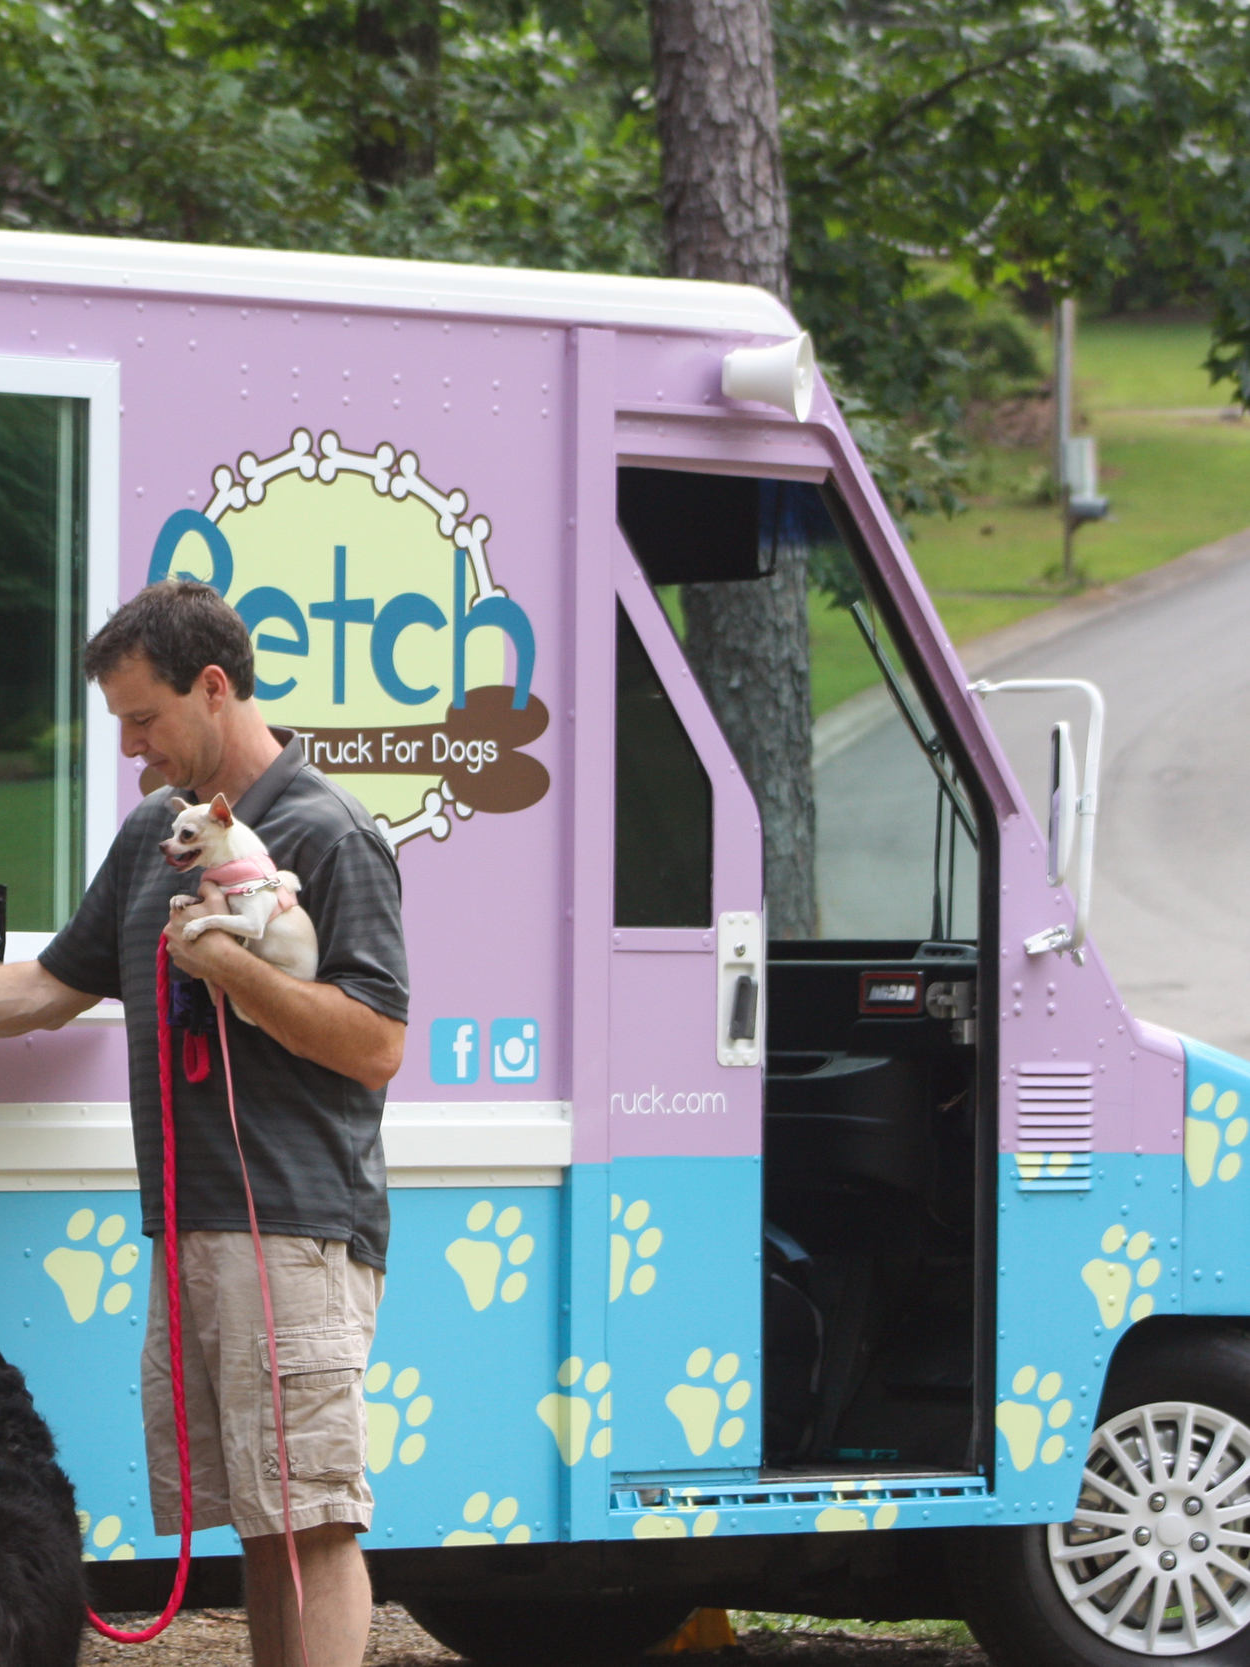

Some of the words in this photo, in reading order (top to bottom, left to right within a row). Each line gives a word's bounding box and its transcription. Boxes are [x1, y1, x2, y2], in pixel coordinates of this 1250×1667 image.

[298, 732, 374, 764] Truck
[381, 731, 424, 763] For
[432, 731, 499, 774] Dogs
[610, 1084, 726, 1115] ruck.com
